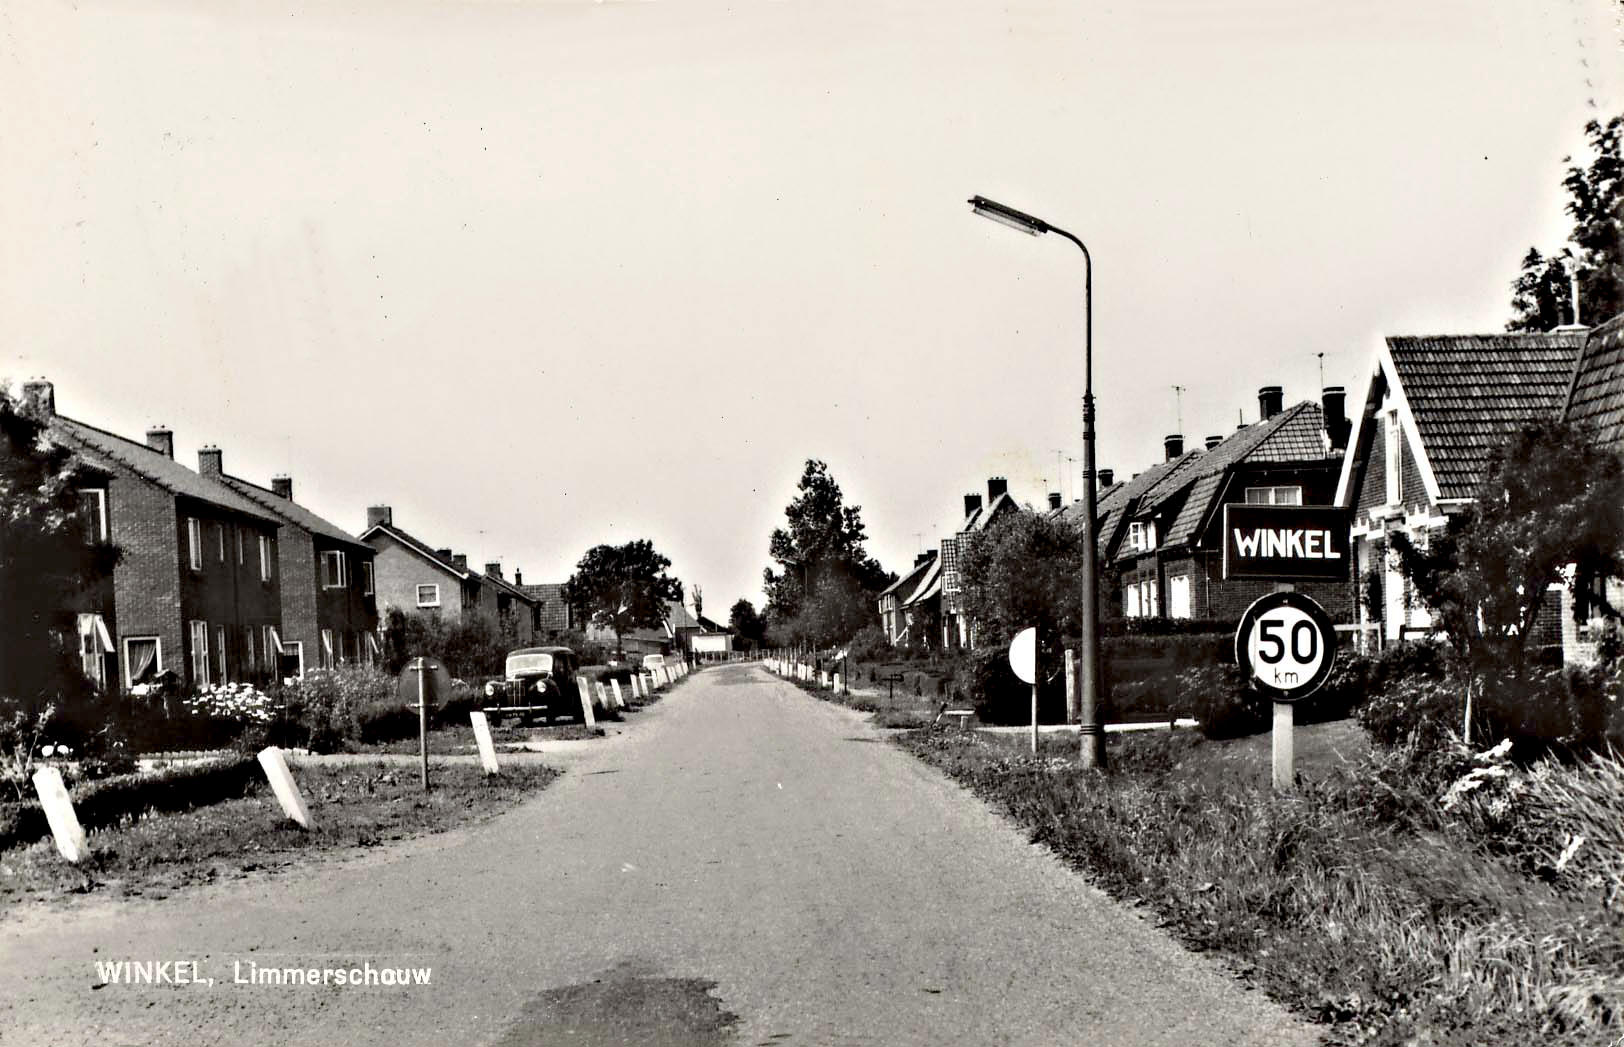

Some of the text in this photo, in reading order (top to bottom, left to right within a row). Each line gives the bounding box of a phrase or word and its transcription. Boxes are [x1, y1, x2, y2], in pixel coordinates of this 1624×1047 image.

[1233, 528, 1341, 559] WINKEL
[1258, 619, 1317, 664] 50
[1274, 668, 1299, 684] km
